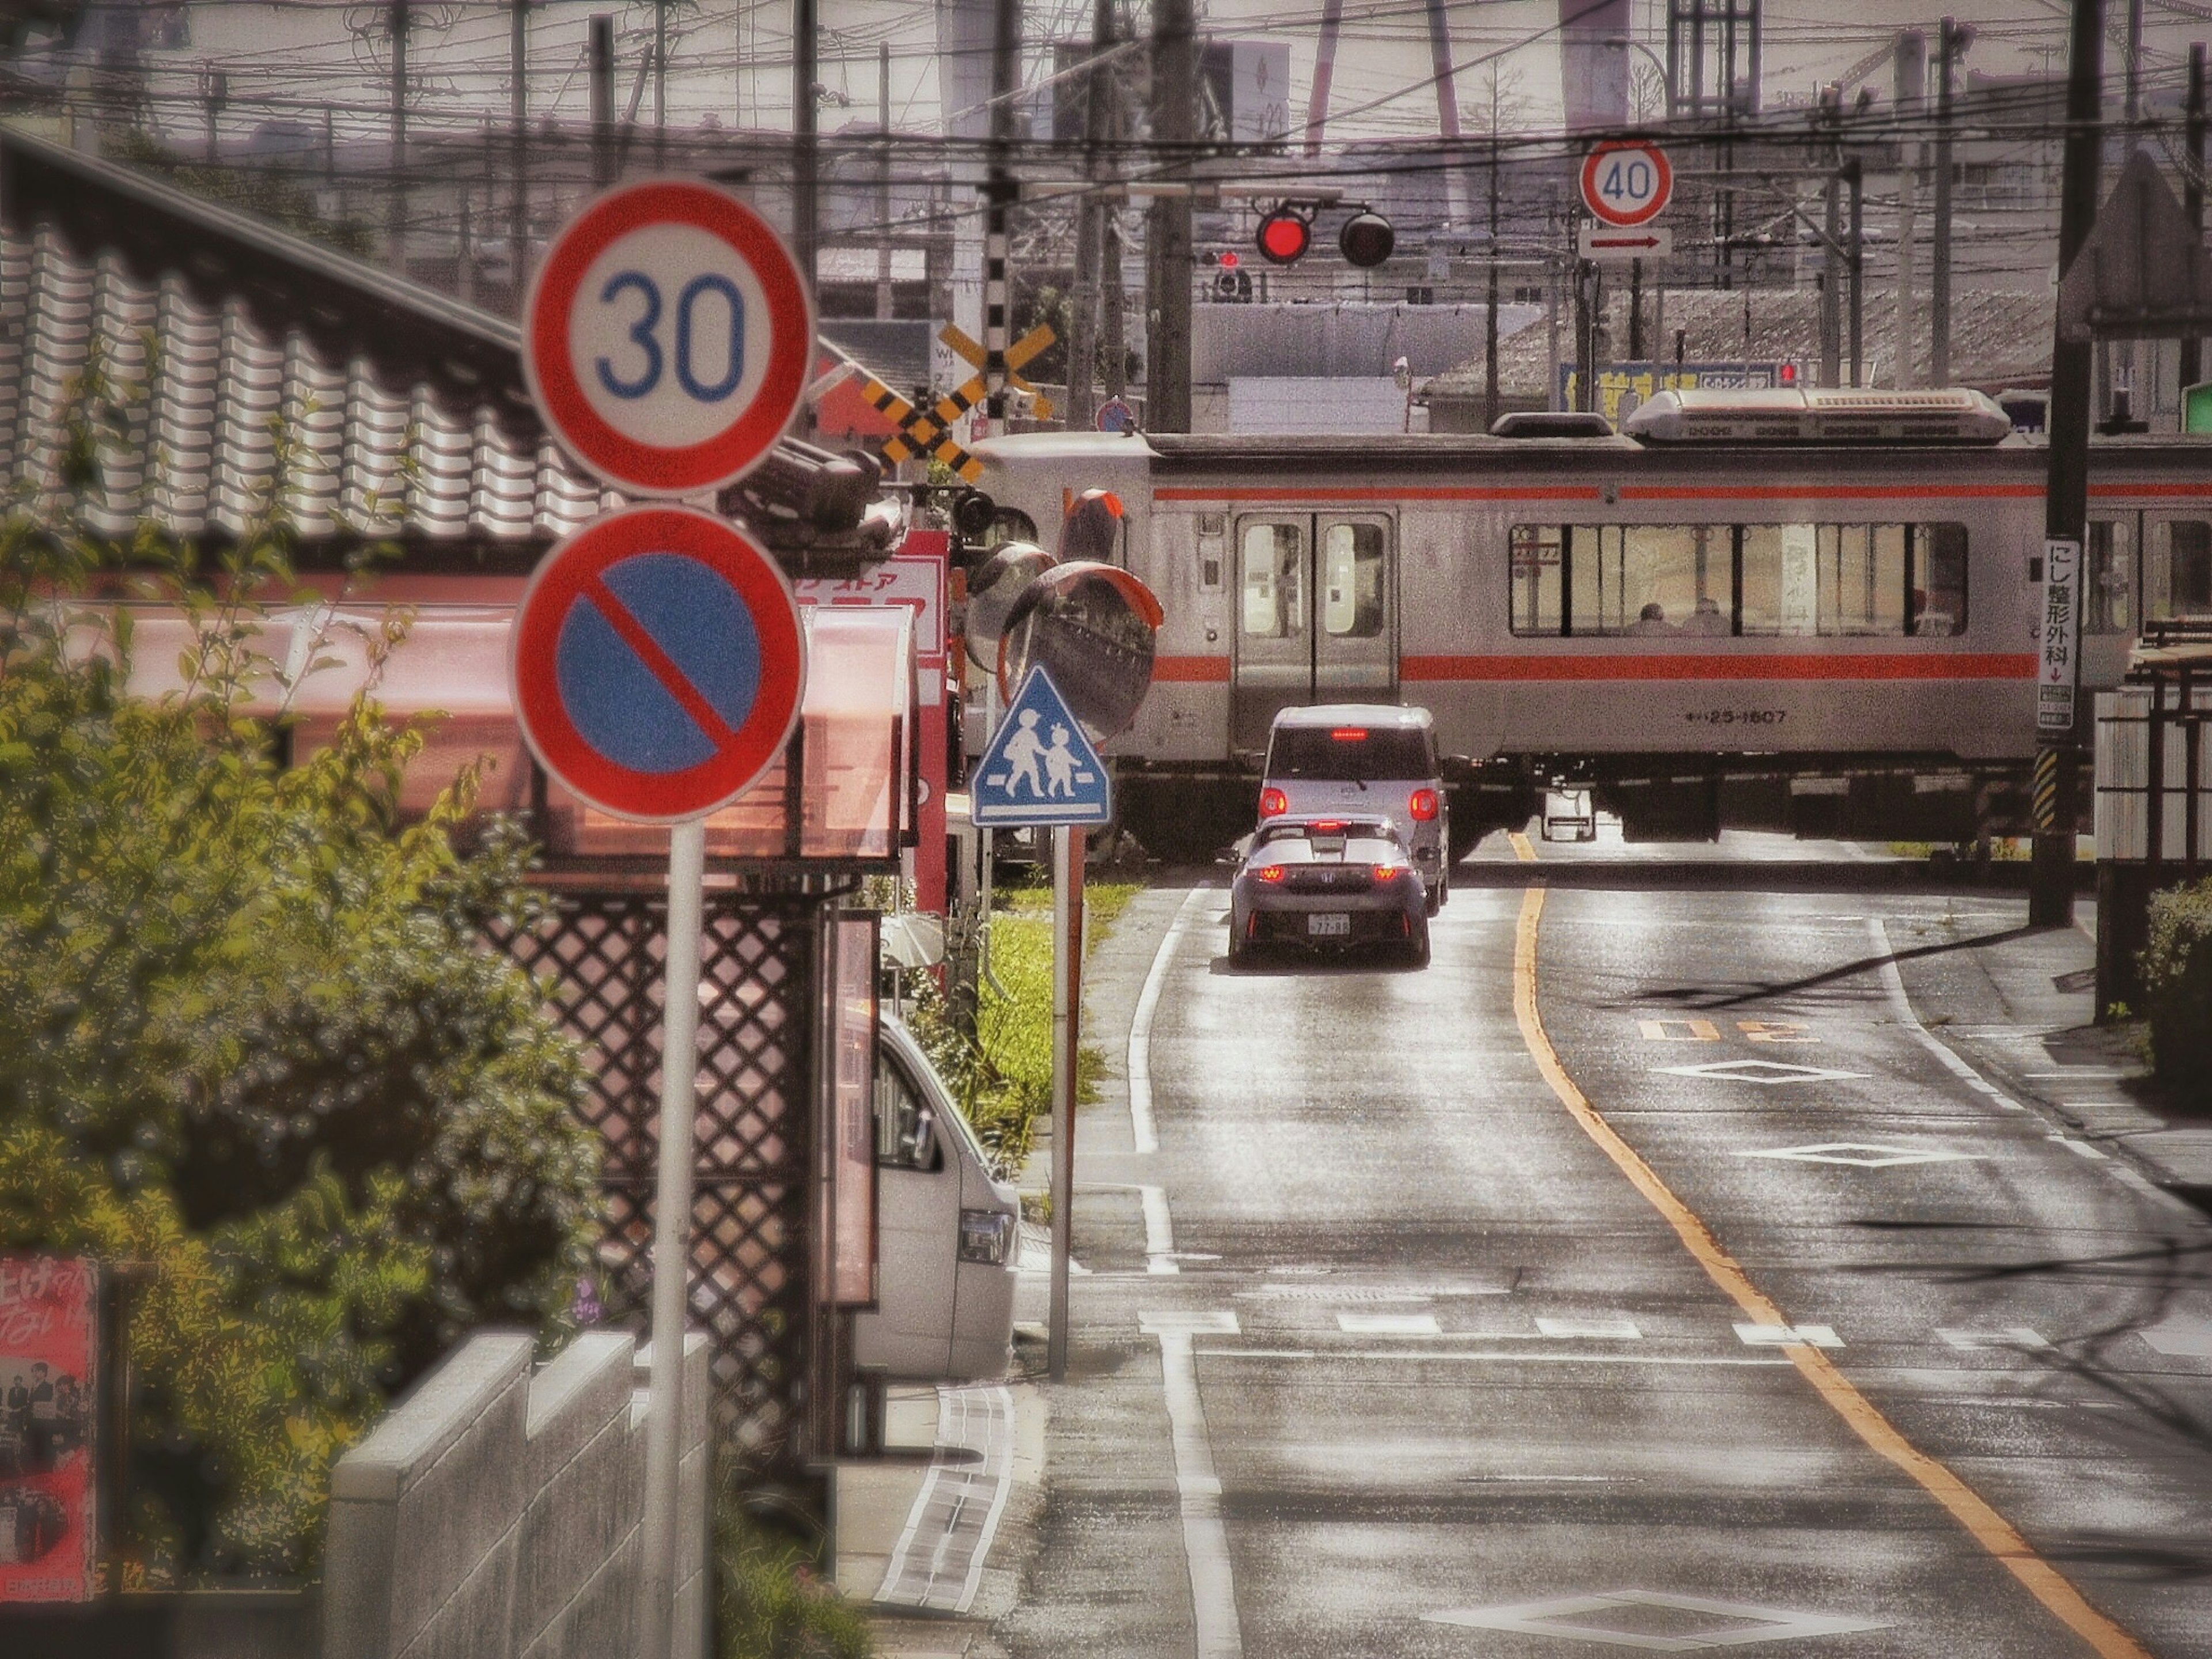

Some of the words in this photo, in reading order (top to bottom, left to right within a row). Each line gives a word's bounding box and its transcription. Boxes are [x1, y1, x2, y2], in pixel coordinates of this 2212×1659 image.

[1603, 161, 1649, 199] 40
[596, 268, 745, 404] 30
[2046, 545, 2071, 666] にし整形外科
